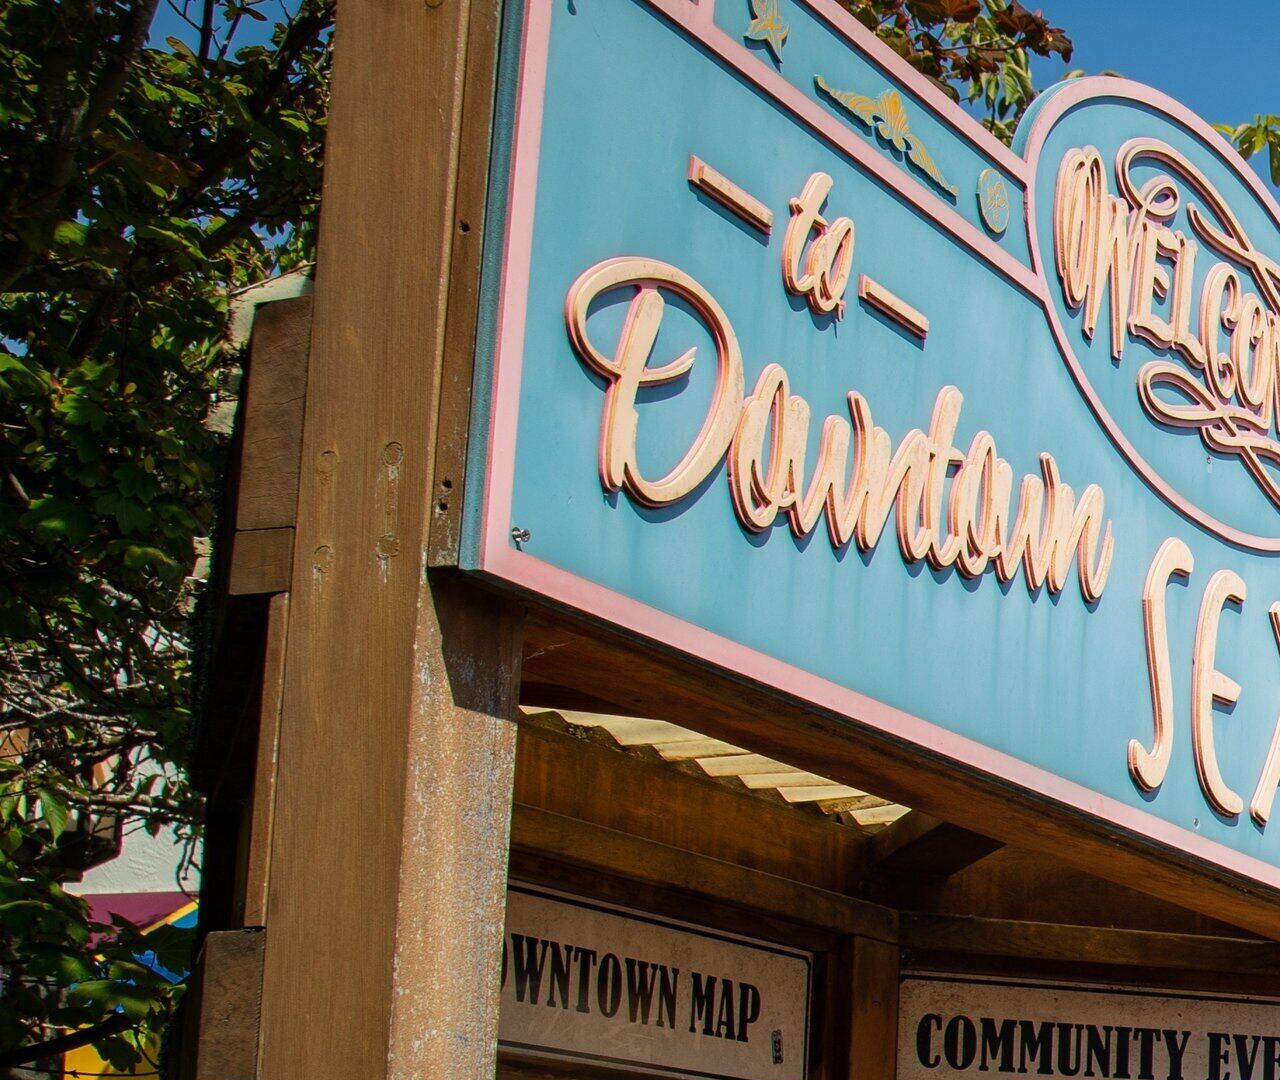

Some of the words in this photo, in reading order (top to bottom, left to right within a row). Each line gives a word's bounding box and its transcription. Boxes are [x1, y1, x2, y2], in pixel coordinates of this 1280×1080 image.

[565, 255, 1114, 603] Downtown
[500, 932, 680, 1030] WNTOWN
[688, 971, 761, 1043] MAP
